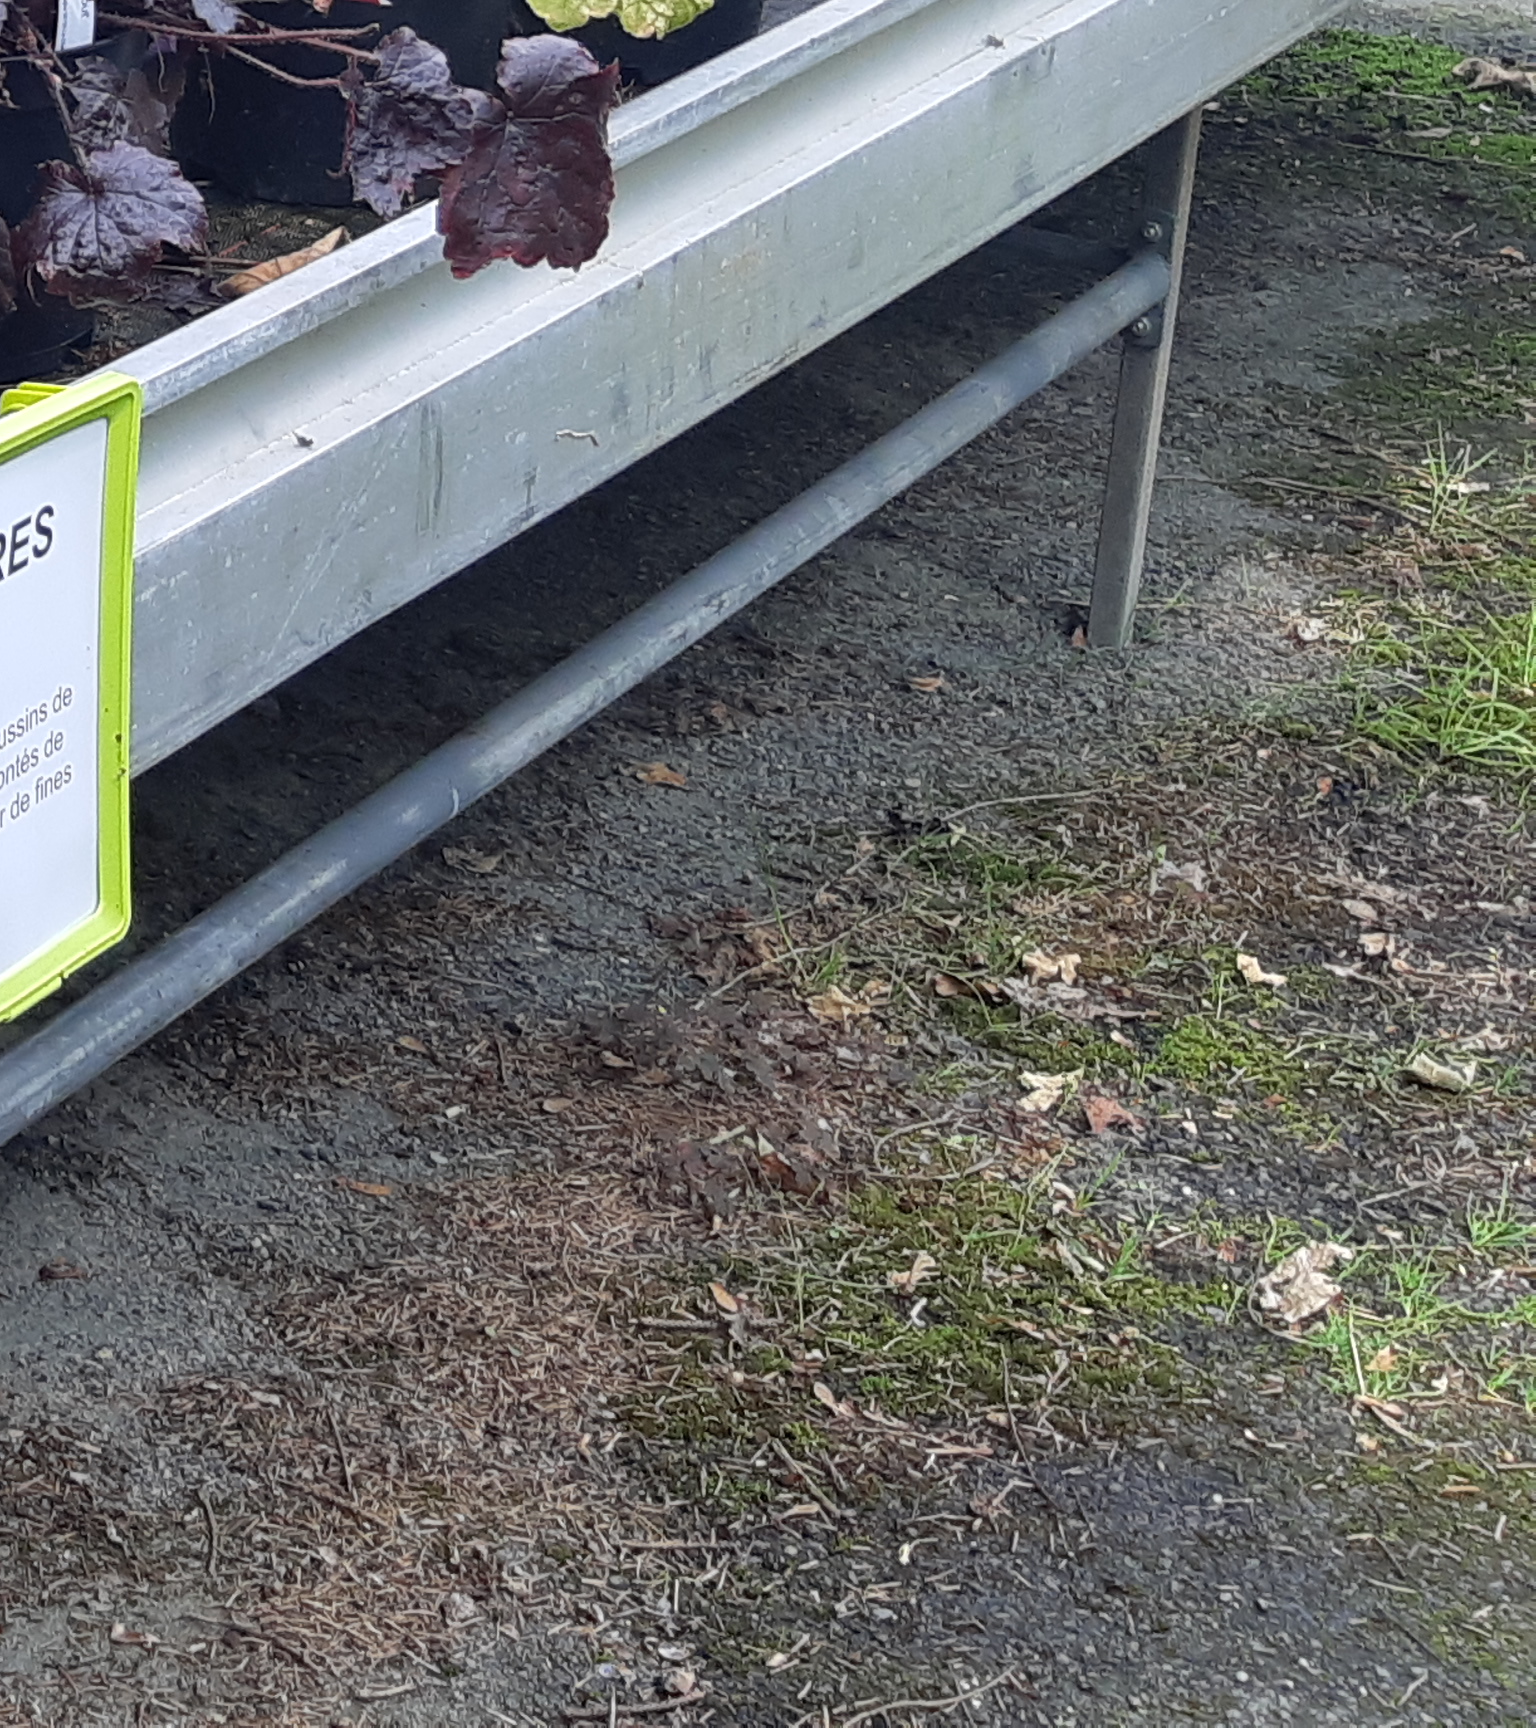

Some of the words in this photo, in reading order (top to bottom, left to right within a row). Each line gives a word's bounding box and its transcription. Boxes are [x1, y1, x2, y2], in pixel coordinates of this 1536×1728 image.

[53, 685, 73, 713] de
[44, 732, 65, 758] de
[10, 793, 30, 820] de
[35, 767, 72, 803] fines
